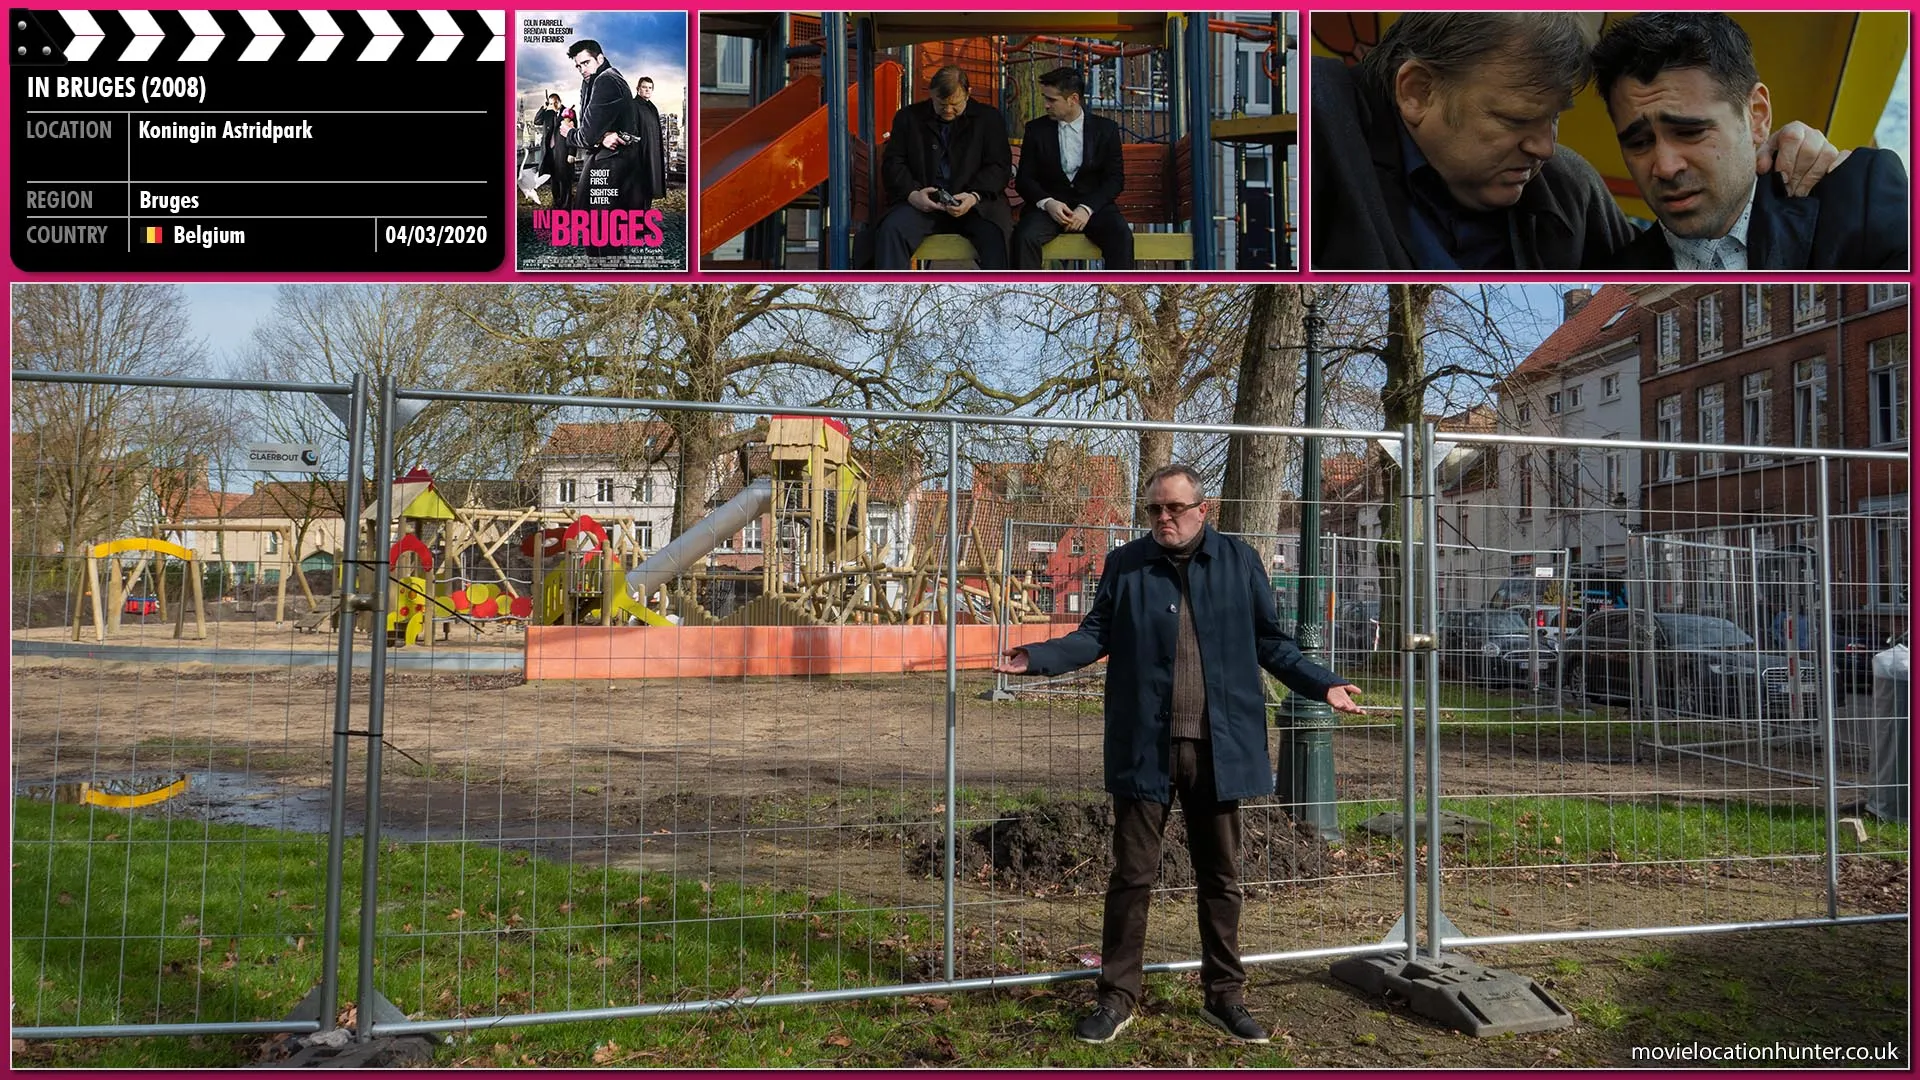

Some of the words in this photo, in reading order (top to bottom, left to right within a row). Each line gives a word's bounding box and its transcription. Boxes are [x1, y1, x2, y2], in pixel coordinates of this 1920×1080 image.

[590, 169, 610, 177] SHOOT
[590, 177, 609, 185] FIRST.
[590, 188, 619, 197] SIGHTSEE
[590, 197, 610, 205] LATER.
[532, 209, 551, 229] IN
[551, 209, 664, 247] BRUGES
[249, 453, 299, 461] CLAERBOUT
